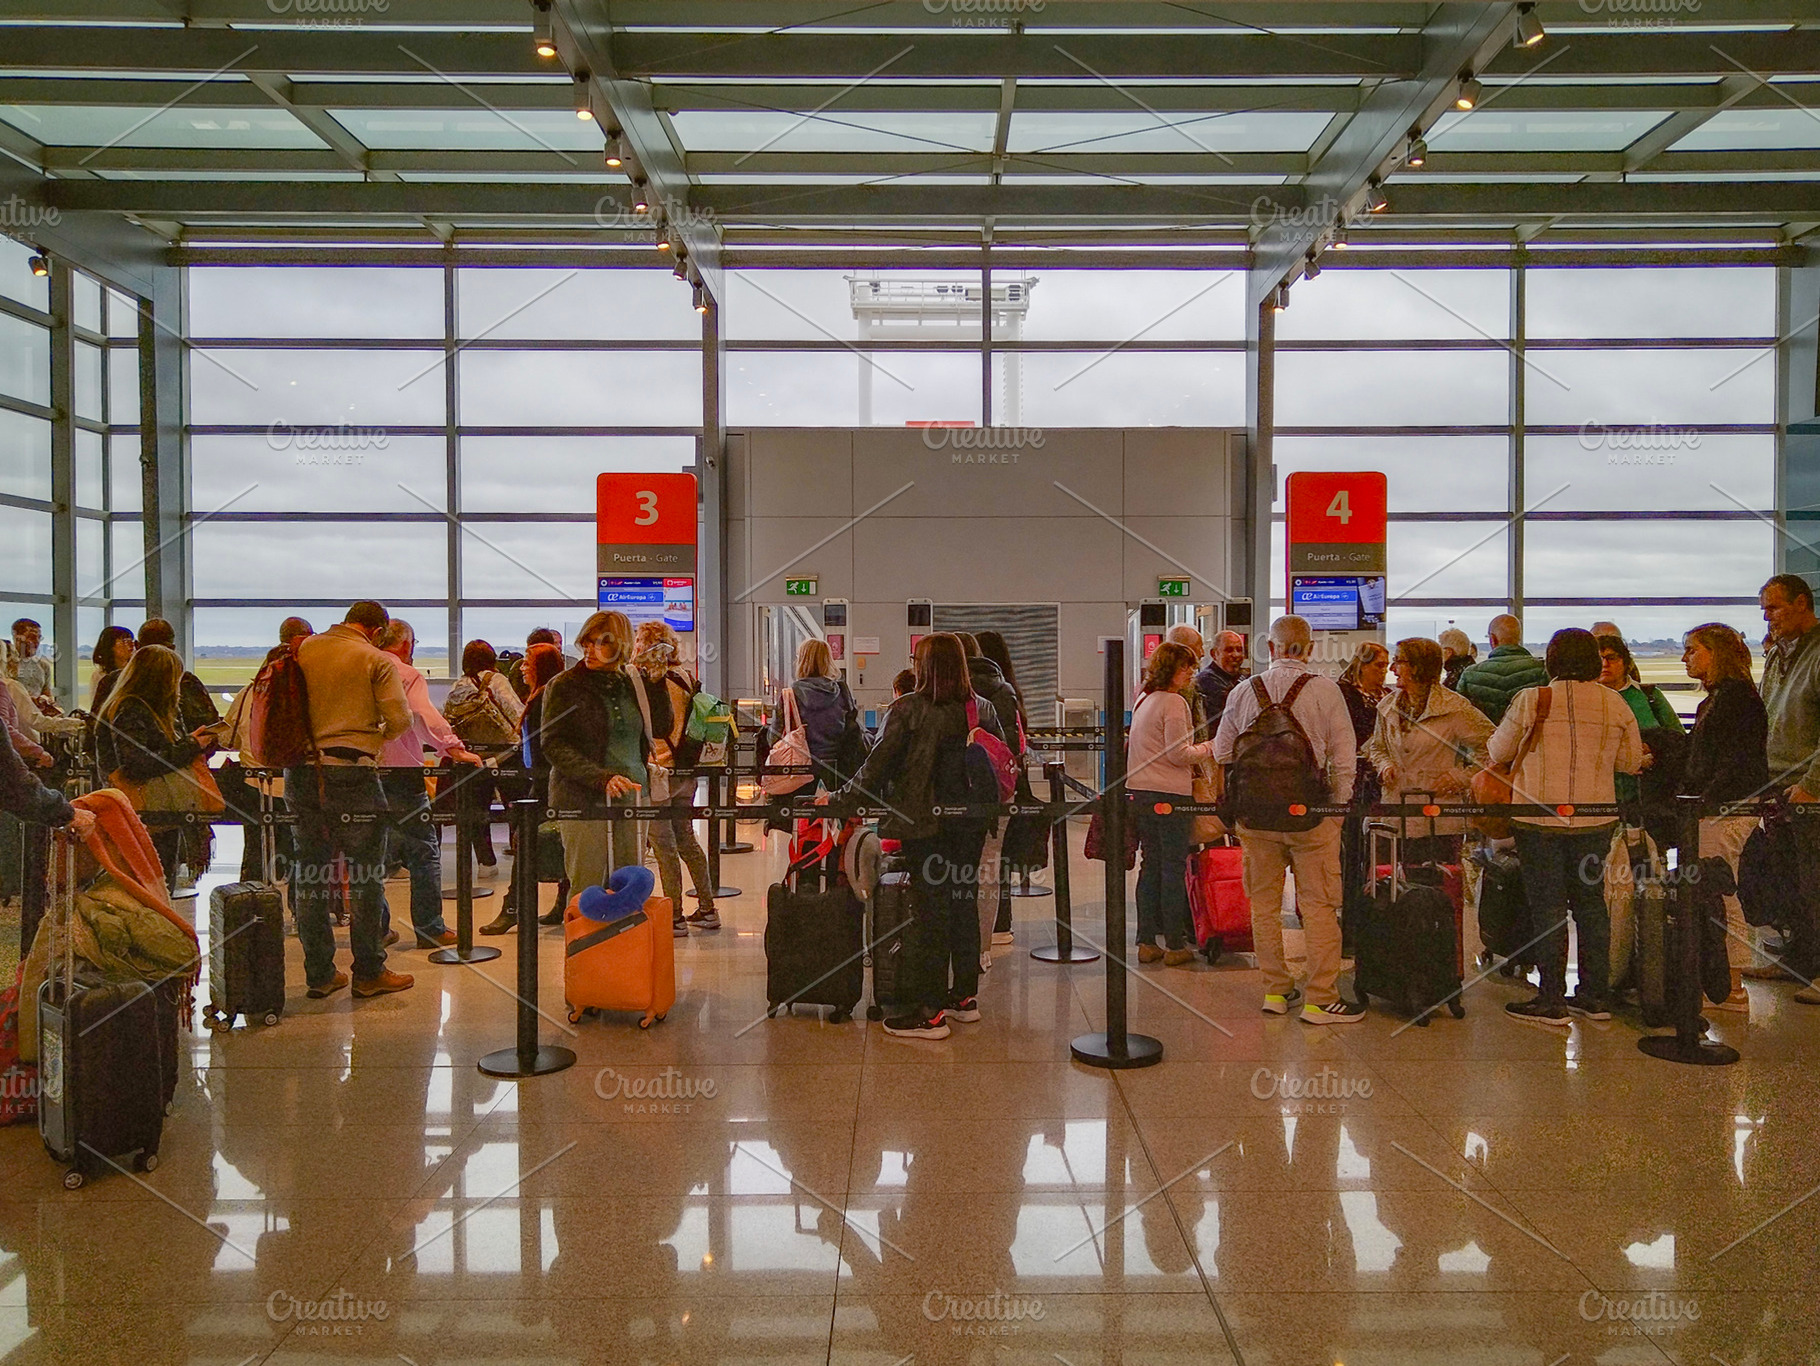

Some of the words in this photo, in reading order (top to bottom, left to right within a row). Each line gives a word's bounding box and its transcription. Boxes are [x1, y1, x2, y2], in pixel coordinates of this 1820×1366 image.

[634, 490, 659, 526] 3
[1326, 490, 1353, 524] 4
[613, 553, 647, 562] Puerta
[655, 553, 678, 562] Gate
[1307, 553, 1340, 561] Puerta
[1349, 553, 1371, 562] Gate
[1174, 804, 1217, 812] mastercard
[1309, 805, 1351, 813] mastercard
[1443, 806, 1485, 814] mastercard
